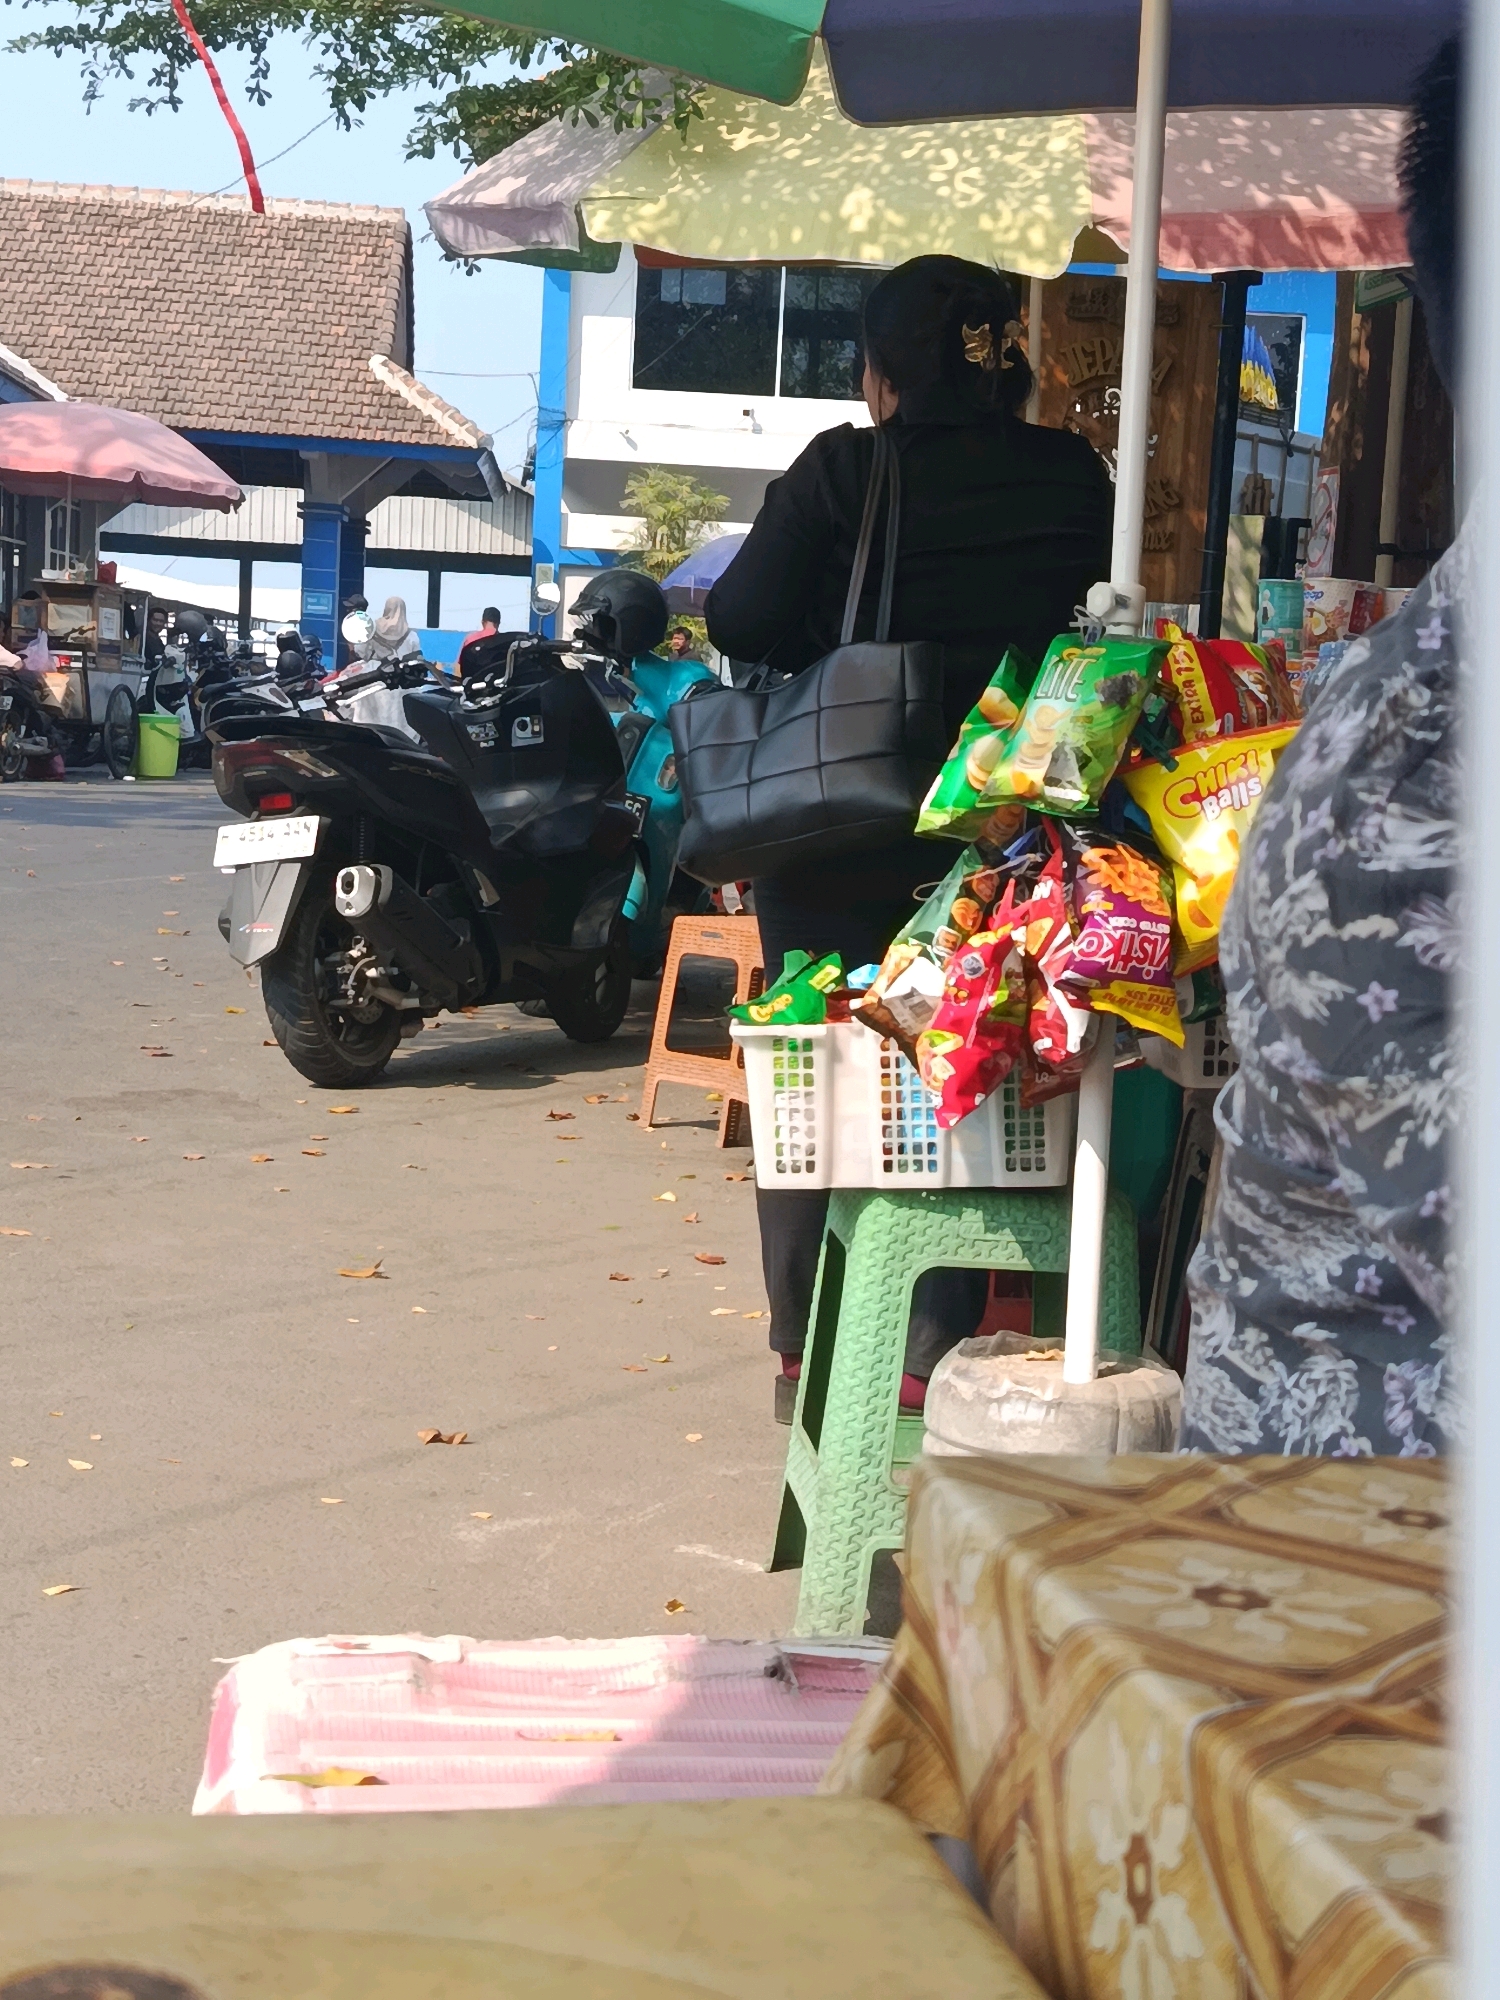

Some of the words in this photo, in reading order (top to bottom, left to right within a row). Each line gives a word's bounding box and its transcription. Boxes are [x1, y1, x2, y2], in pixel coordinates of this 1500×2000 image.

[1182, 679, 1205, 724] EXTRA
[1163, 749, 1260, 819] CHIKI
[1201, 776, 1262, 822] Balls
